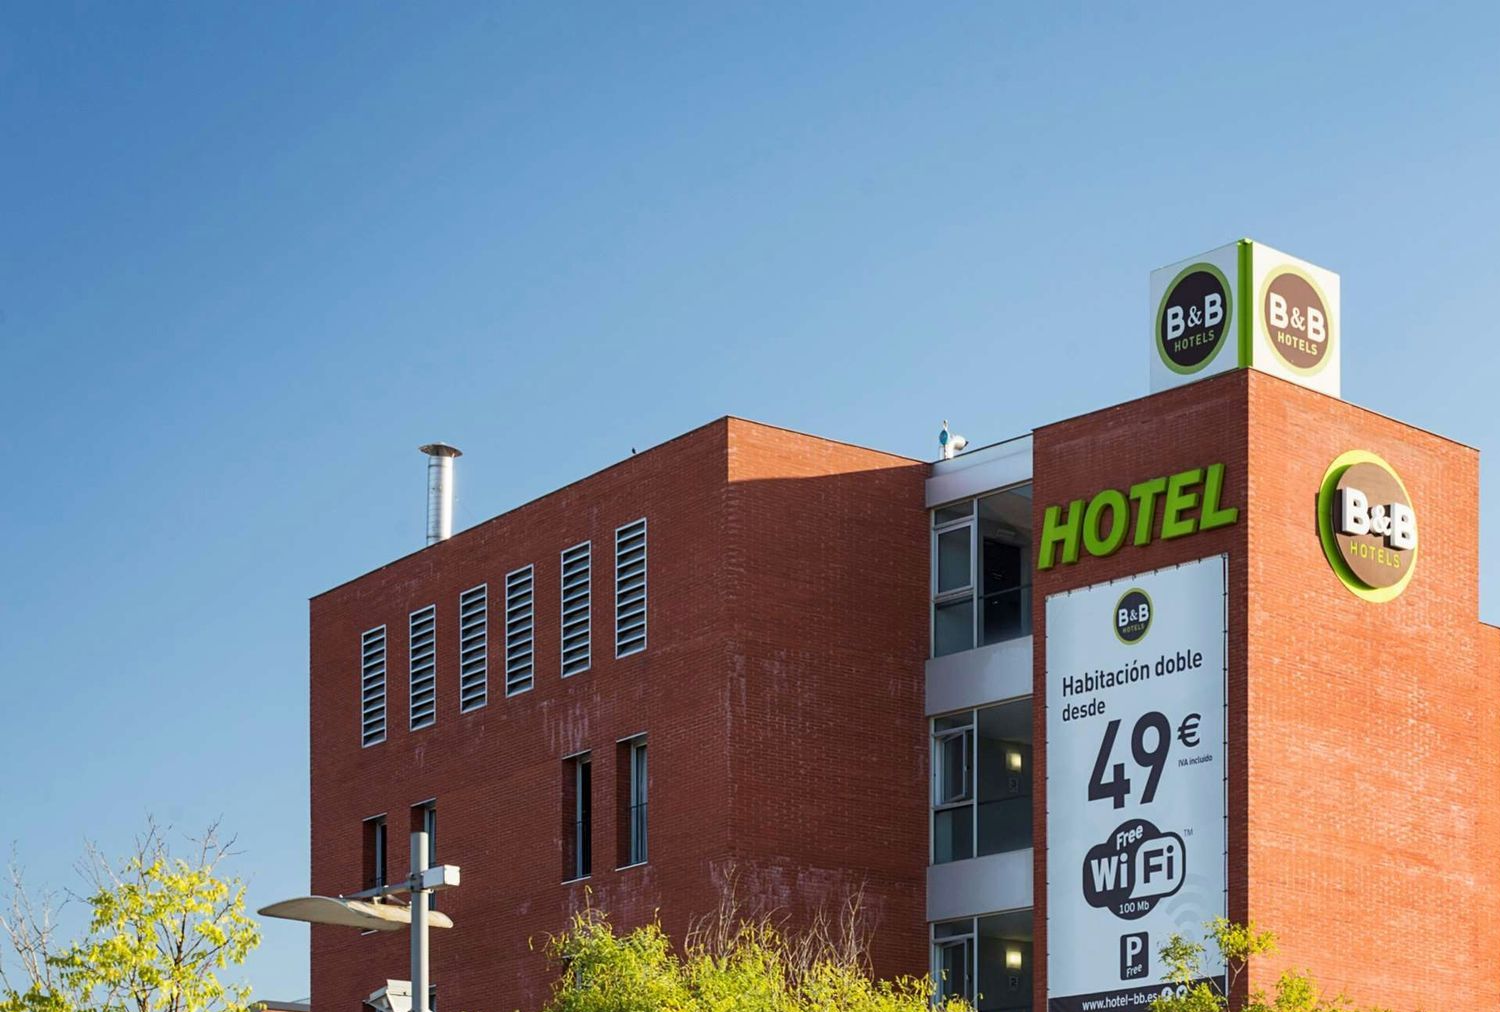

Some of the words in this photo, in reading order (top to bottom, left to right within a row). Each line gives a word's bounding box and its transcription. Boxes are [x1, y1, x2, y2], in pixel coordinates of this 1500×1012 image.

[1167, 292, 1224, 341] B&B
[1269, 292, 1326, 343] B&B
[1174, 330, 1215, 353] HOTELS
[1277, 330, 1318, 356] HOTELS
[1037, 463, 1239, 570] HOTEL
[1340, 486, 1416, 551] B&B
[1349, 540, 1401, 569] HOTELS
[1118, 603, 1150, 627] B&B
[1062, 660, 1150, 697] Habitación
[1155, 649, 1203, 677] doble
[1062, 698, 1106, 722] desde
[1116, 825, 1144, 851] Free
[1119, 901, 1136, 915] 100
[1137, 899, 1150, 912] Mb
[1126, 935, 1143, 967] P
[1126, 963, 1143, 978] Free
[1082, 991, 1158, 1011] www.hotel-bb.es
